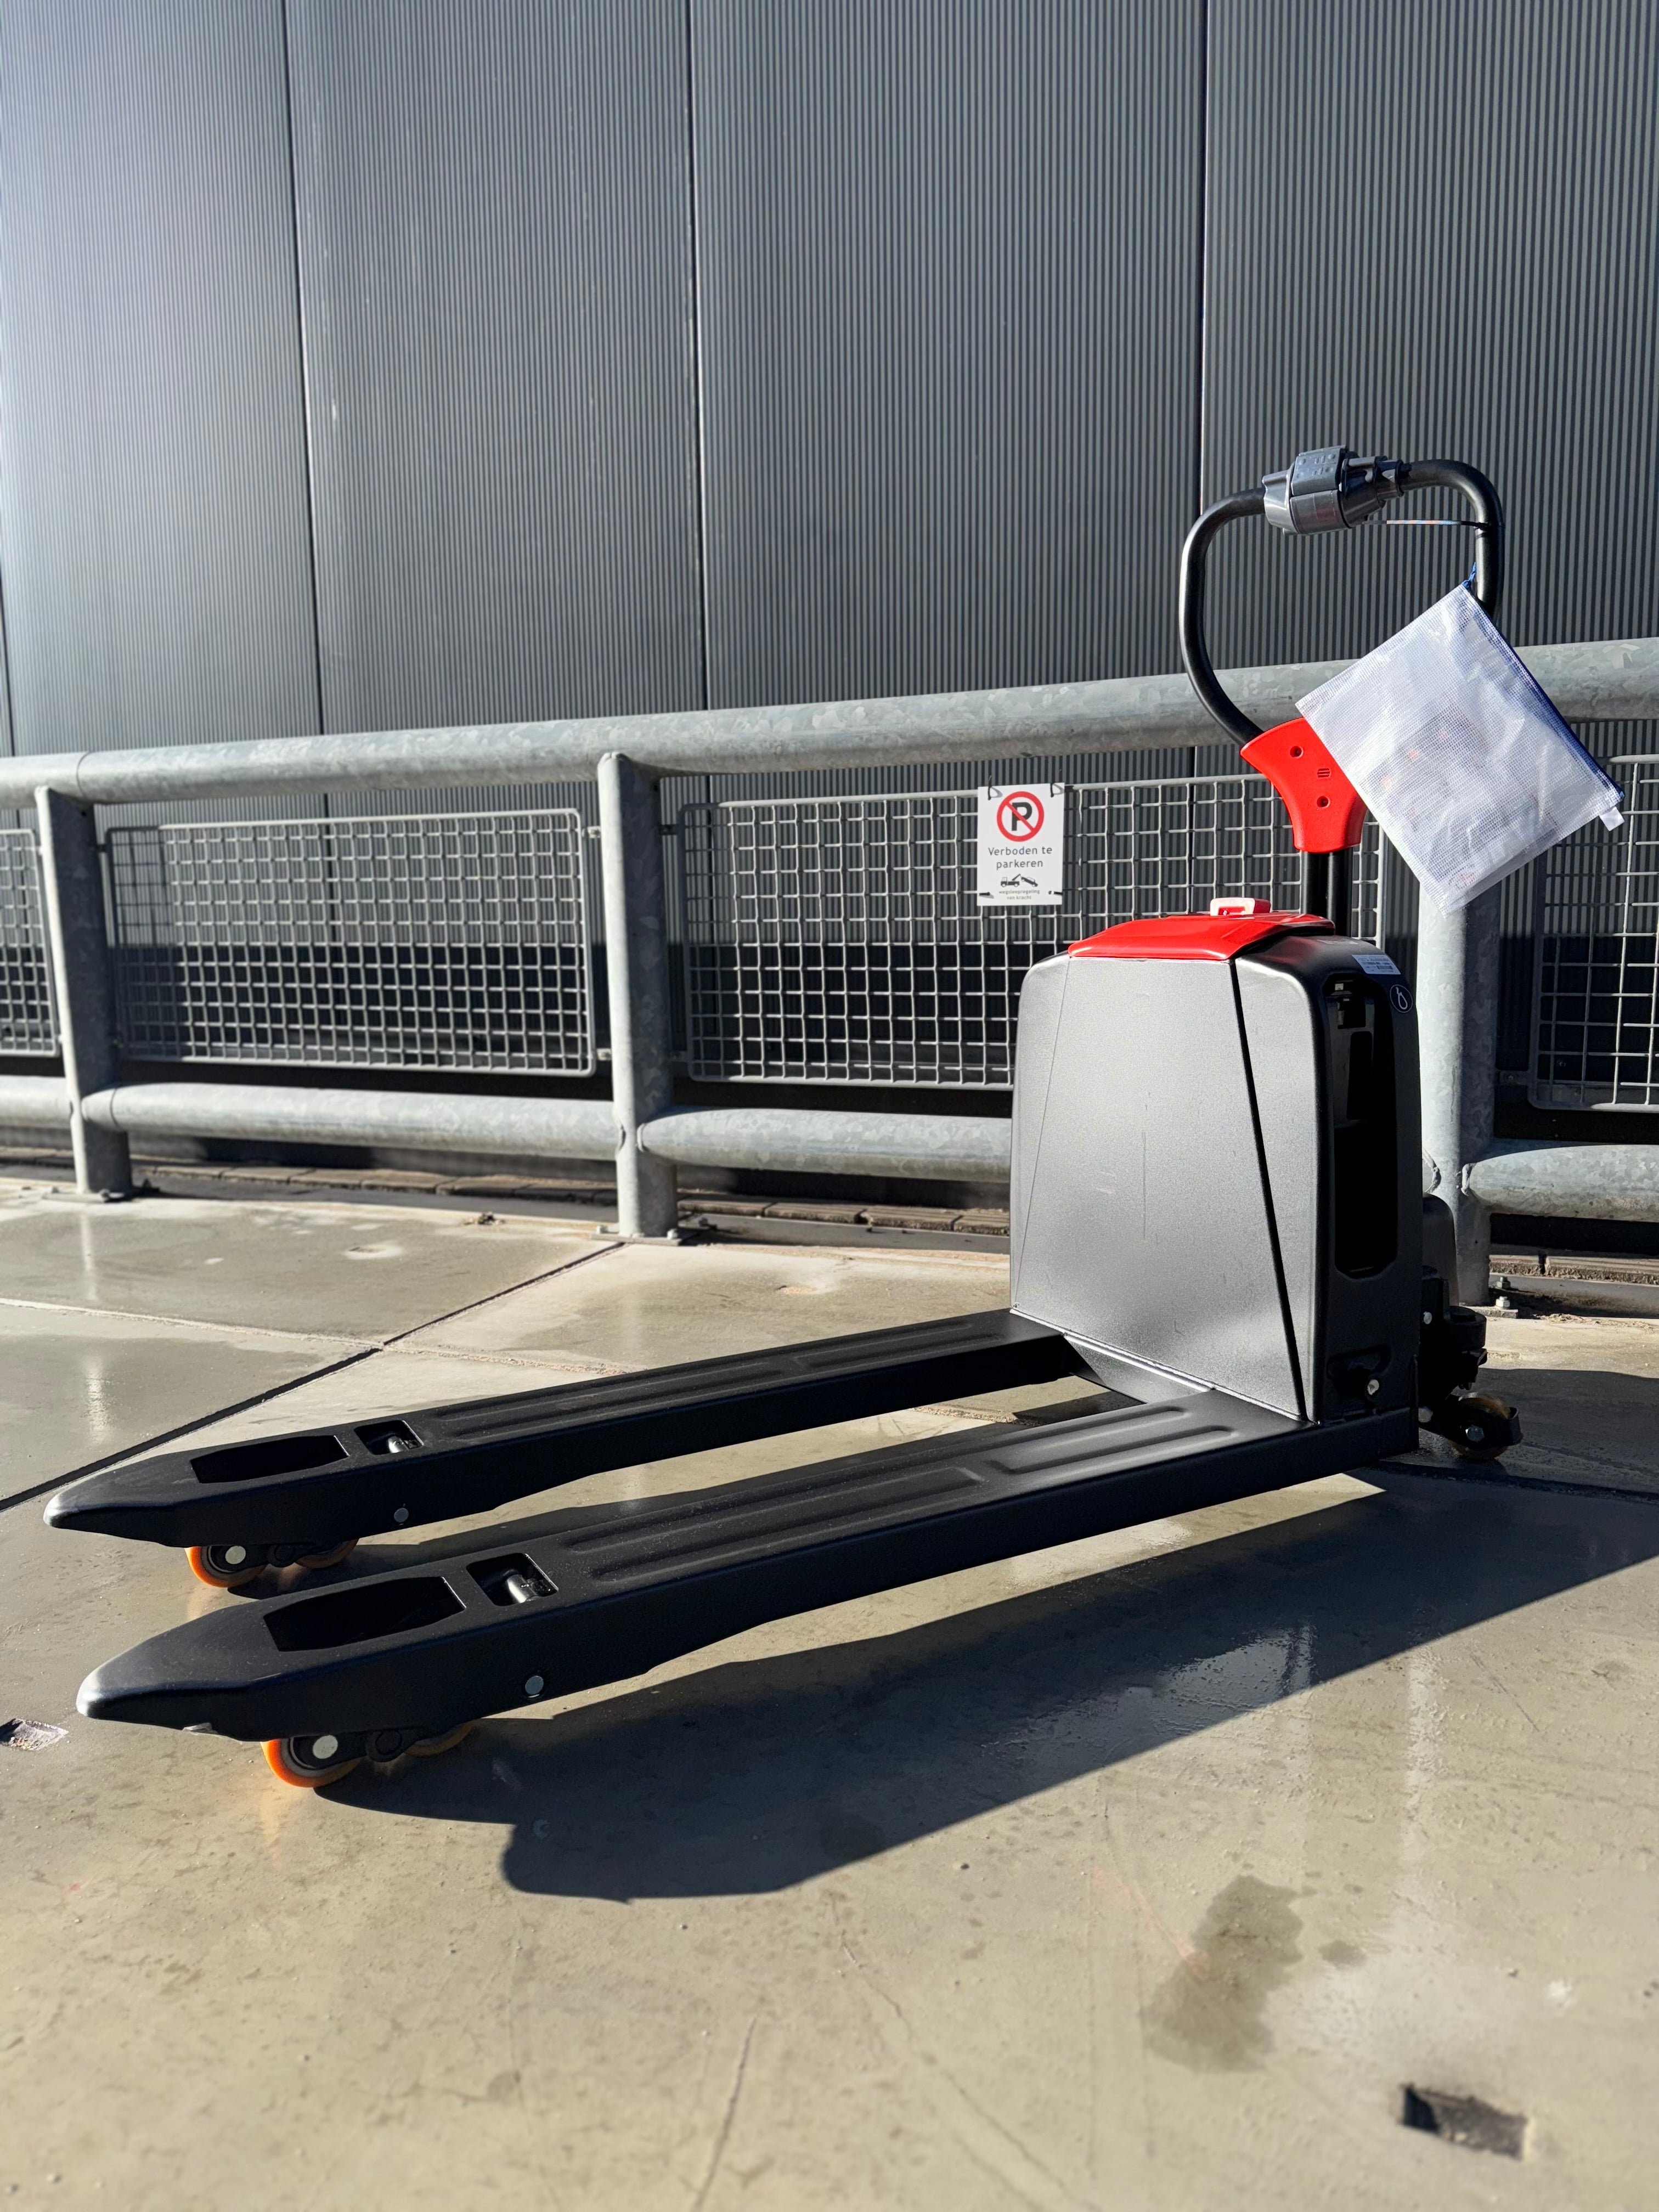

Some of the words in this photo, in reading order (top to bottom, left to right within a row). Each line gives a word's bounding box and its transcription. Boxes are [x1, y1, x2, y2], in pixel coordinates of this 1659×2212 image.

[988, 847, 1037, 856] Verboden
[1042, 846, 1052, 854] te
[996, 859, 1043, 871] parkeren
